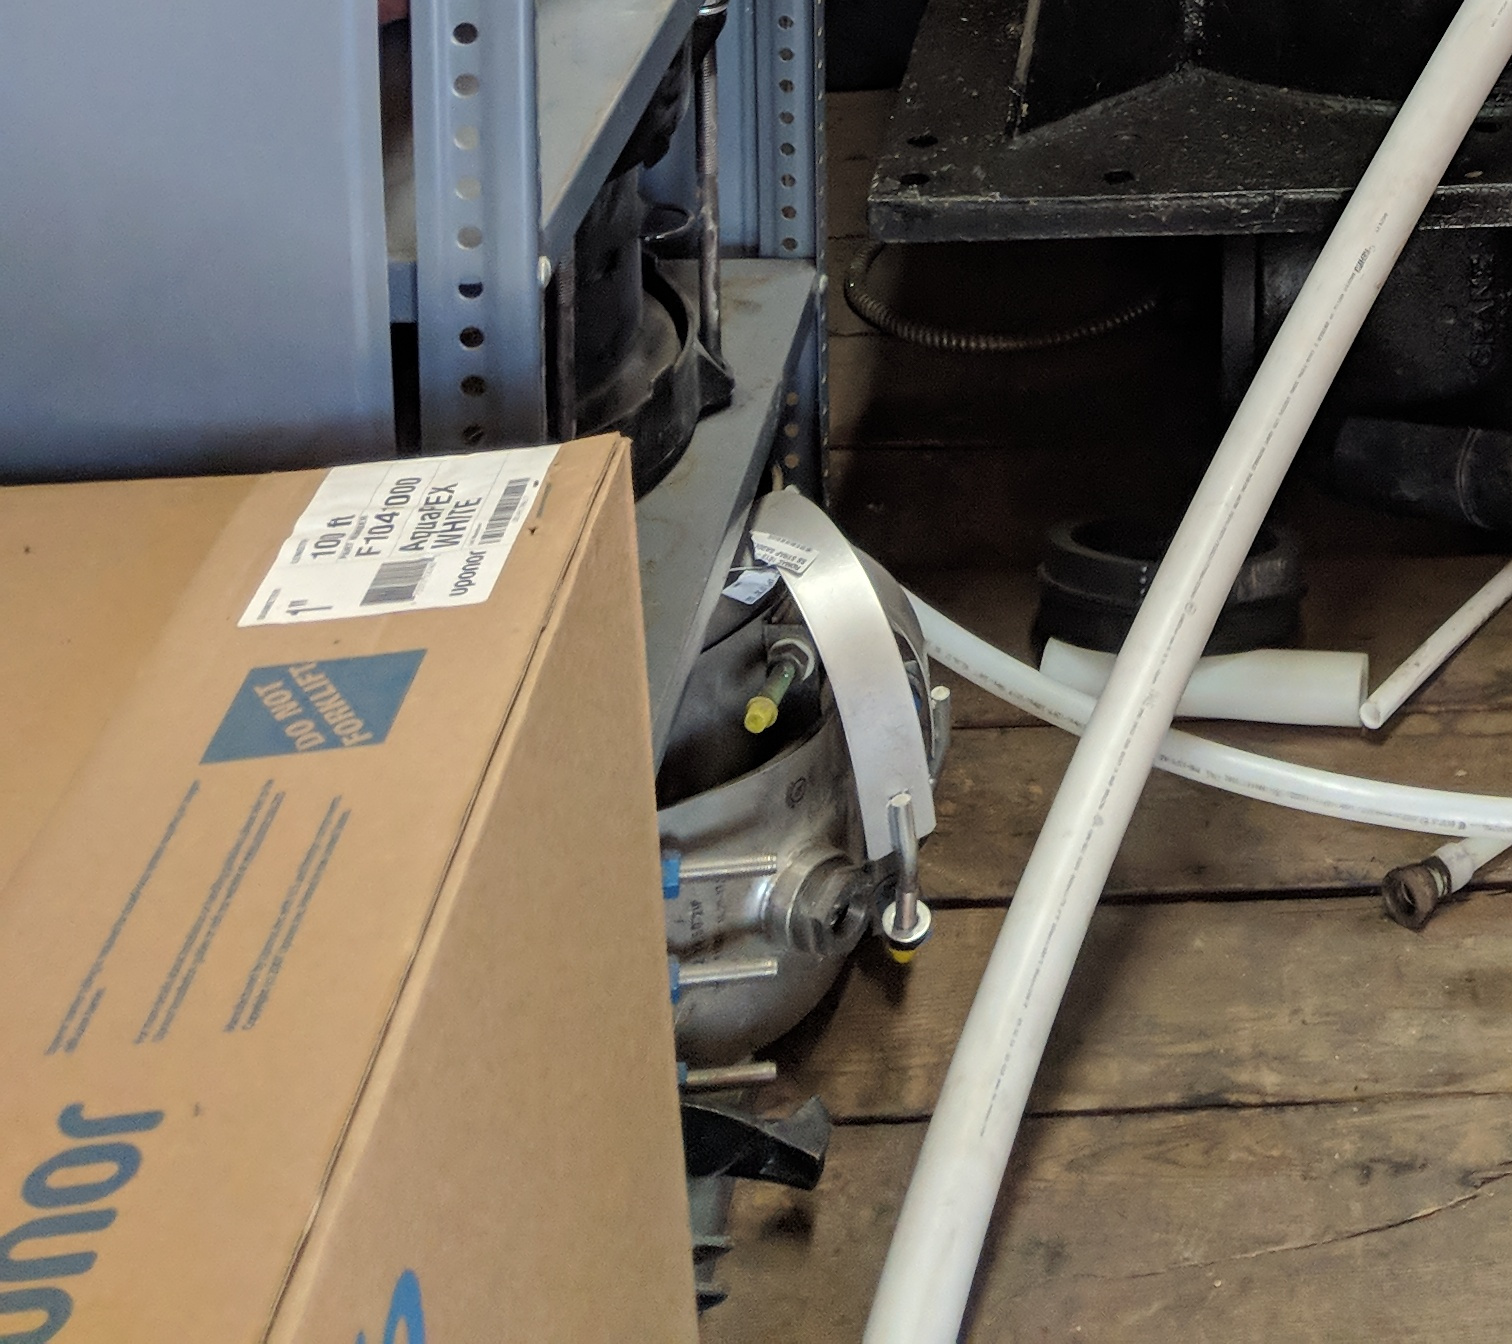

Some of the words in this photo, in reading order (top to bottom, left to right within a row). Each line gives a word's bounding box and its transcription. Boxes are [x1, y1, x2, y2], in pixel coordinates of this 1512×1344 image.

[328, 514, 356, 528] ft
[431, 497, 482, 550] WHITE
[450, 550, 487, 598] uponor
[253, 680, 303, 722] NOT
[288, 661, 375, 747] FORKLIFT
[284, 718, 326, 752] DO
